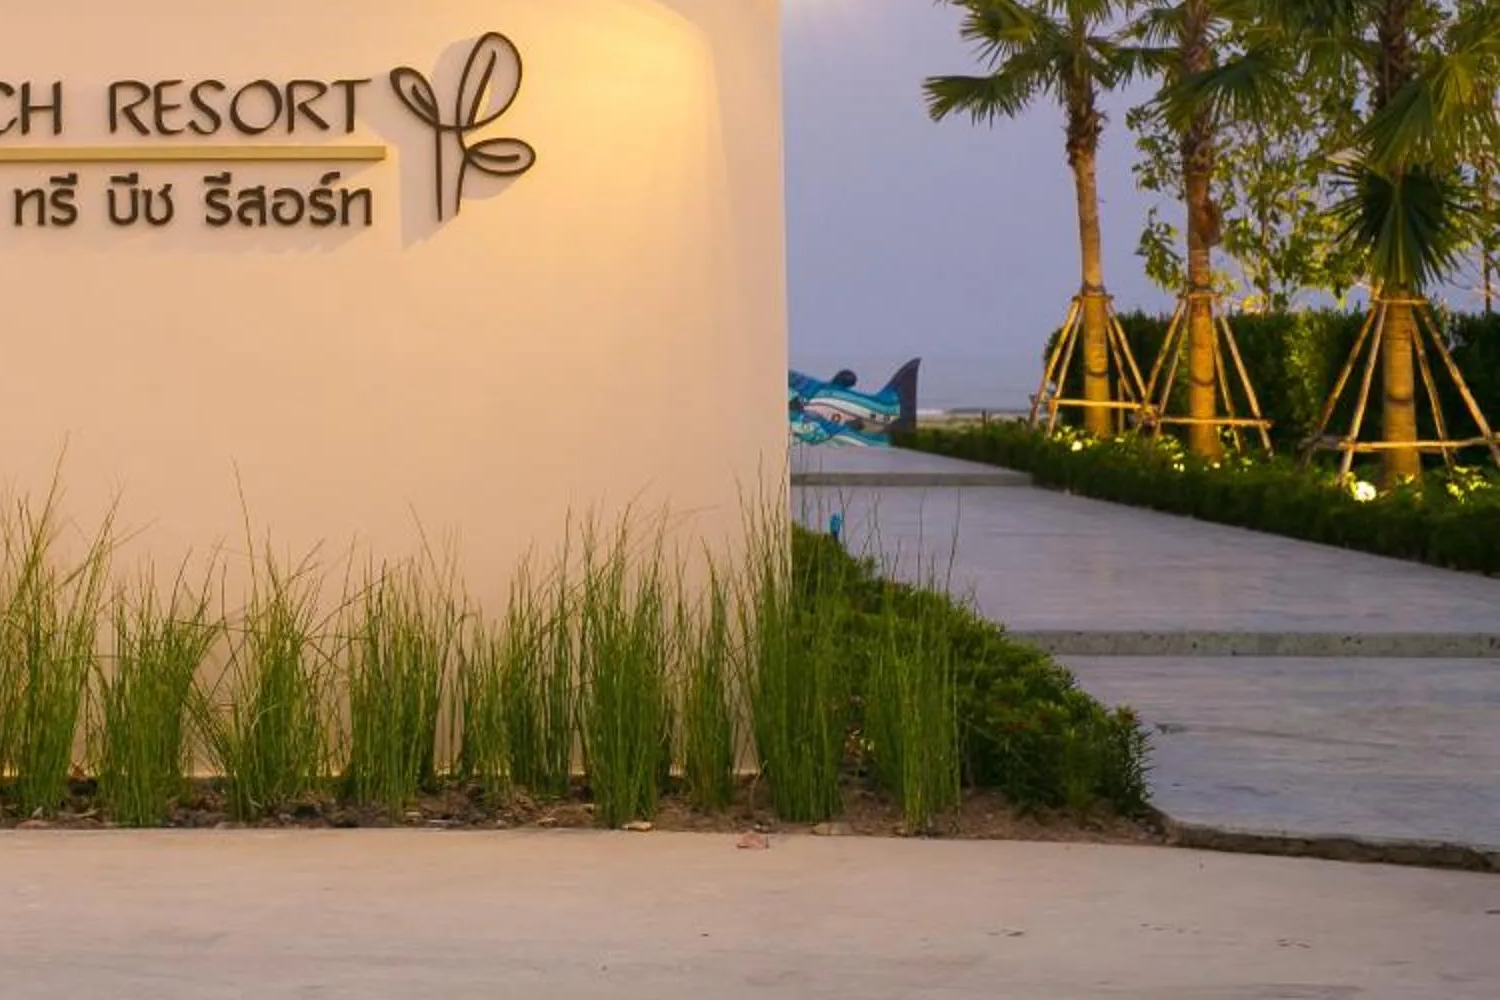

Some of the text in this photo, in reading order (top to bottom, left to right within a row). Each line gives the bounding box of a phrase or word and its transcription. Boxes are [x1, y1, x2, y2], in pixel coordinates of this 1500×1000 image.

[107, 78, 373, 136] RESORT
[12, 172, 79, 228] ทรี
[105, 171, 175, 228] บีช
[202, 170, 374, 228] รีสอร์ท
